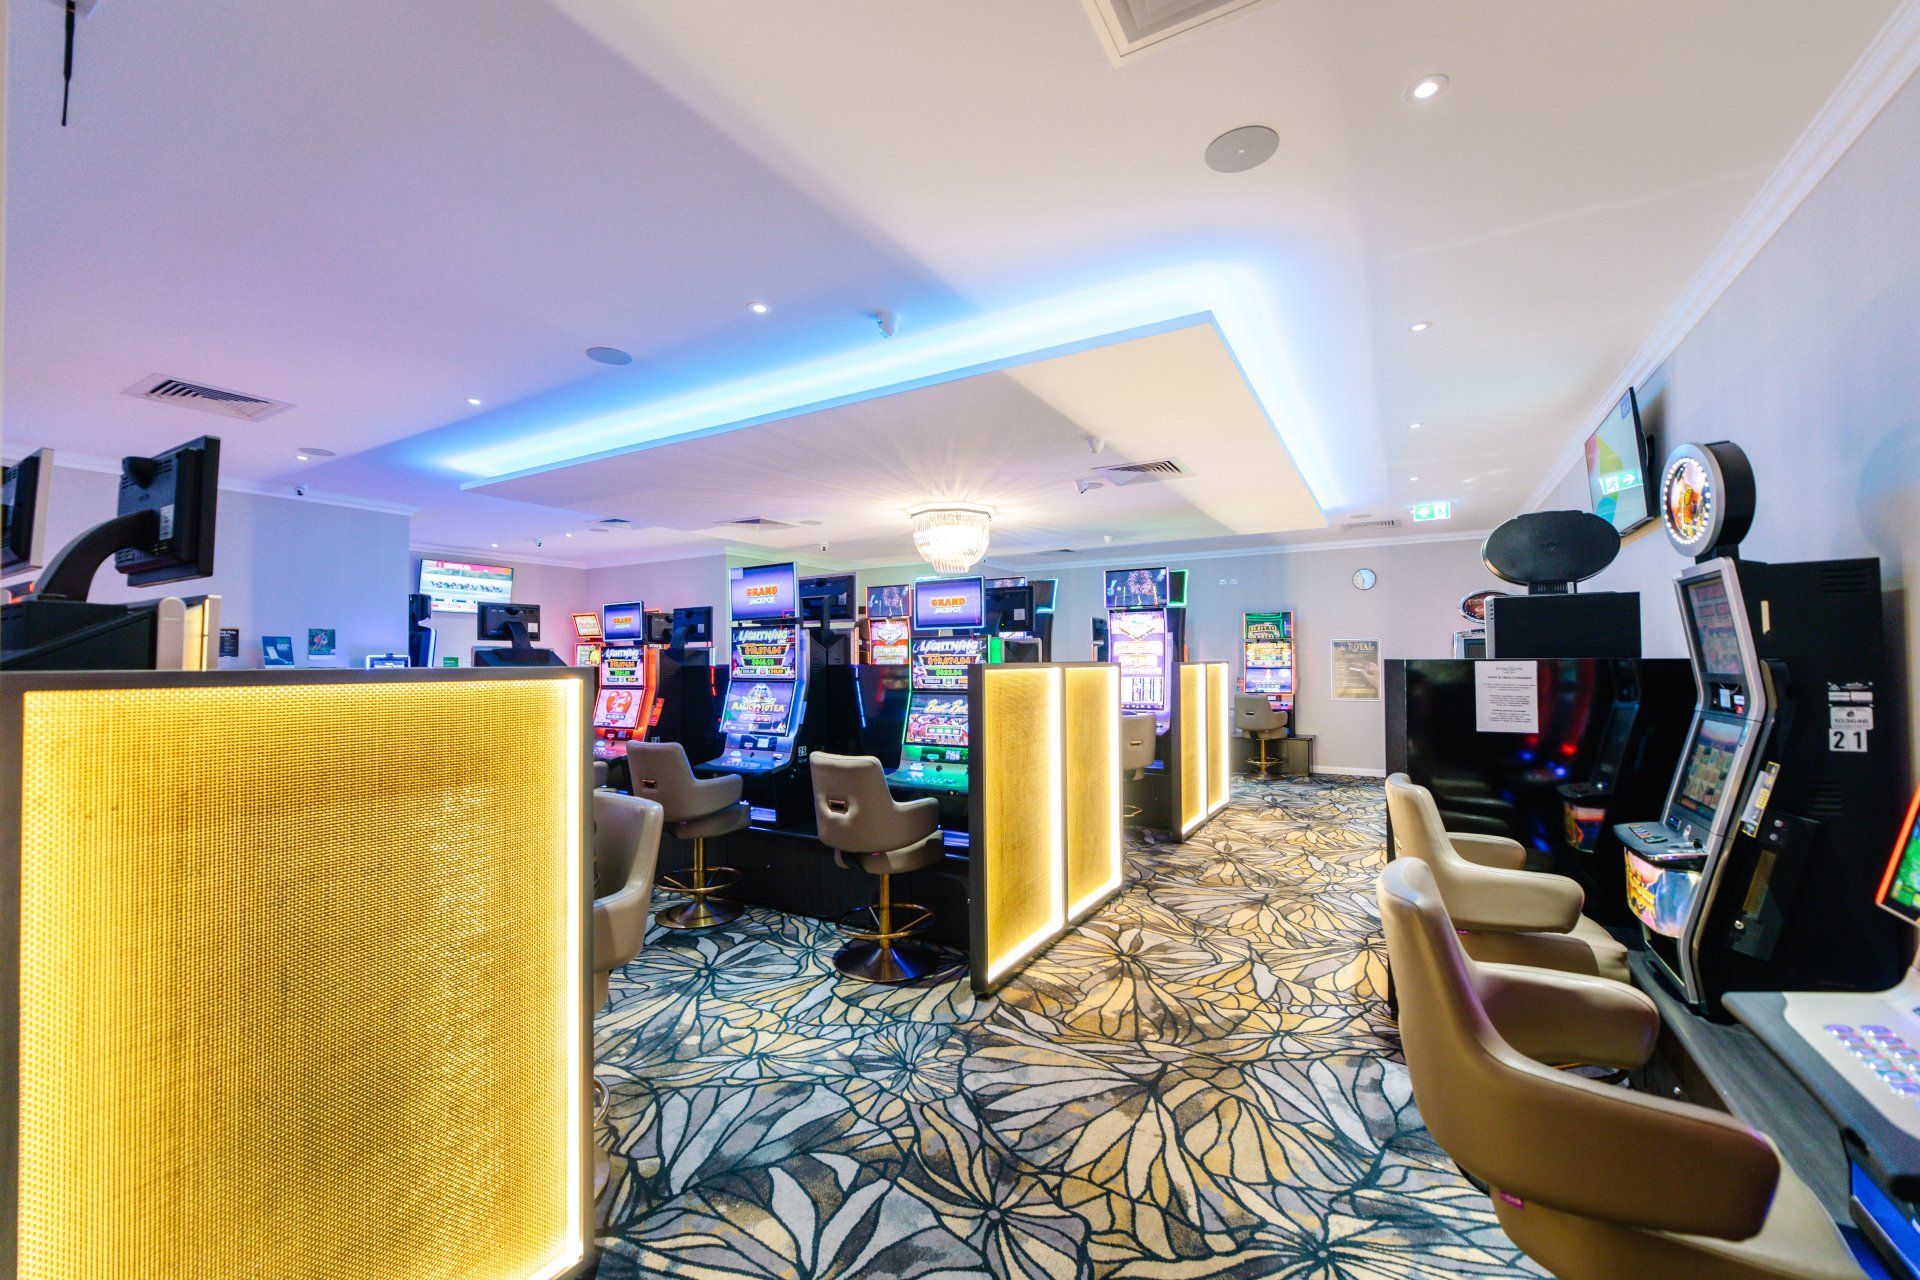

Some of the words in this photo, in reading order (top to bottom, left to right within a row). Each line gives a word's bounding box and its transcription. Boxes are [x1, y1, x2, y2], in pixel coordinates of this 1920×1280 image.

[745, 586, 778, 597] GRAND
[931, 597, 966, 607] GRAND
[1833, 731, 1862, 749] 21
